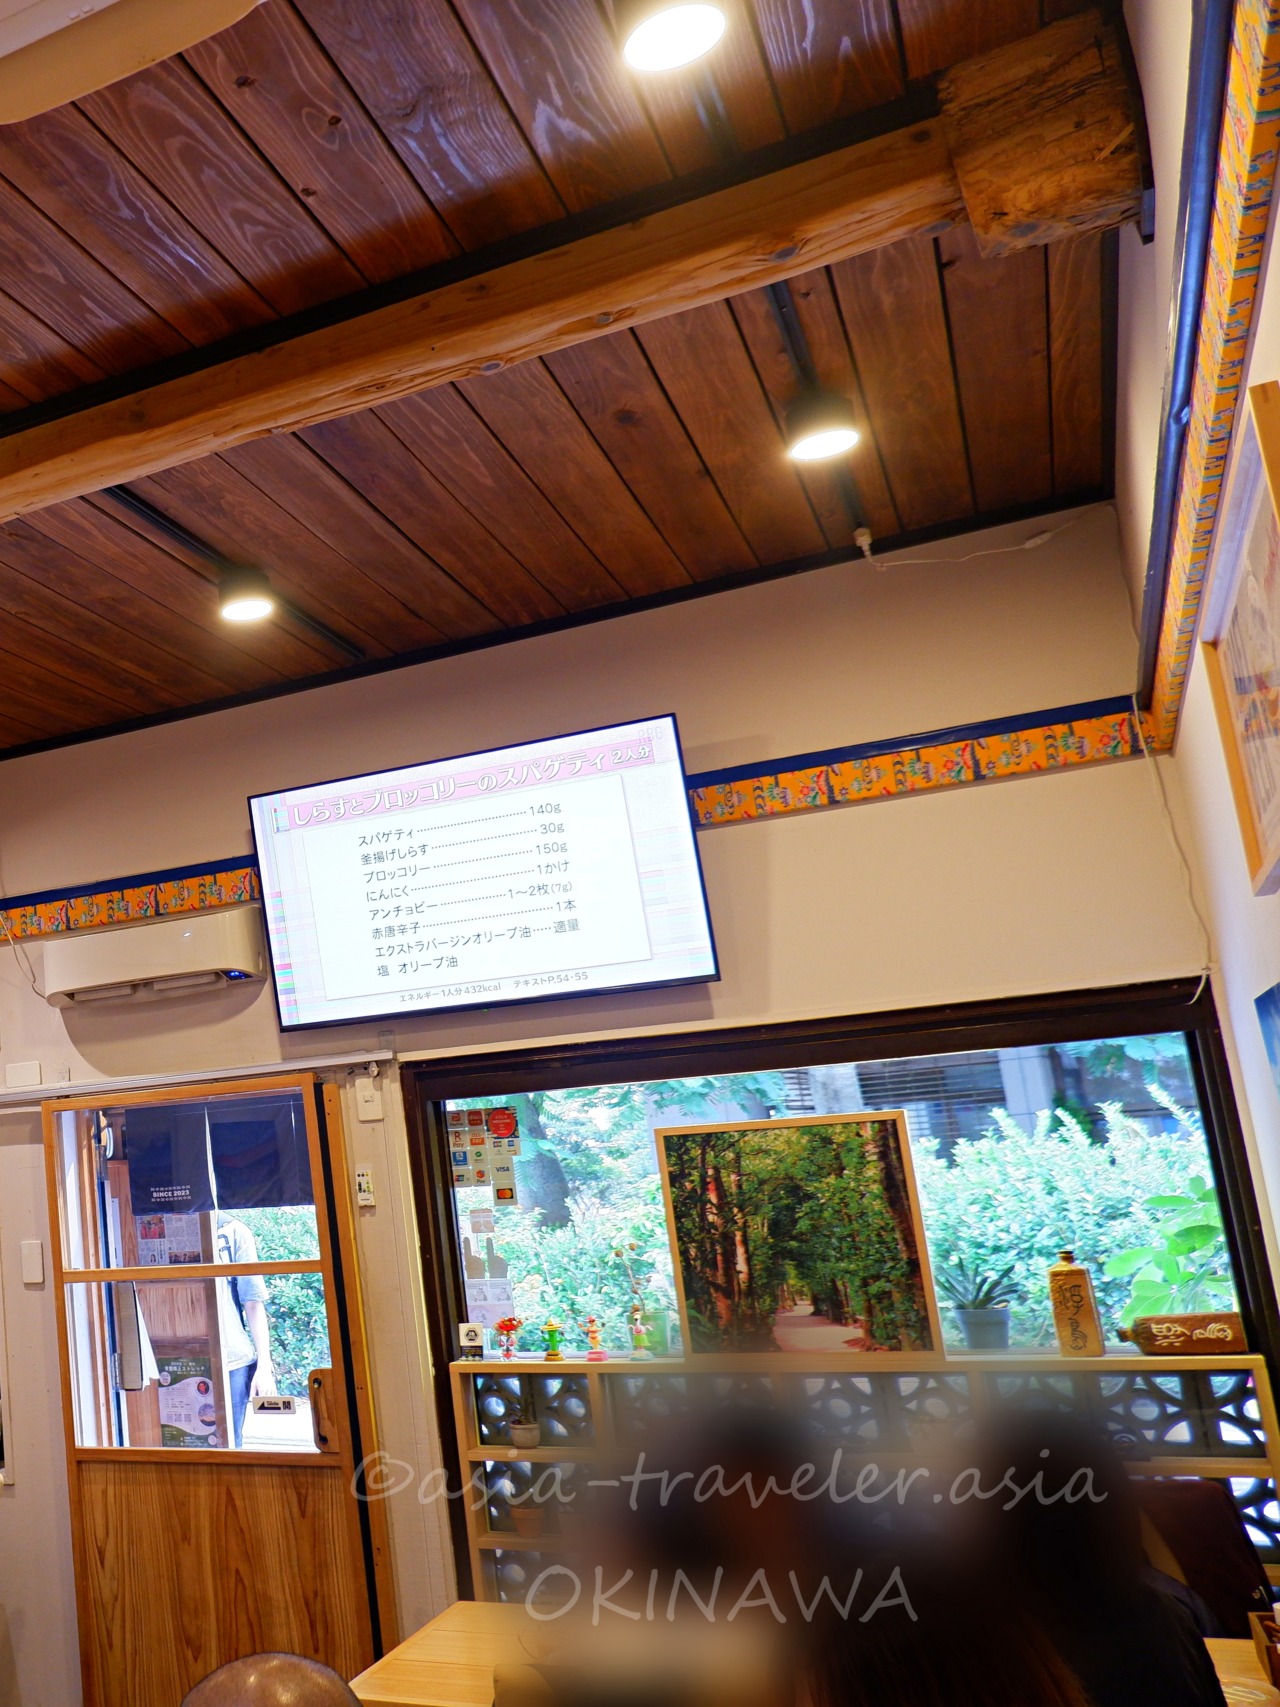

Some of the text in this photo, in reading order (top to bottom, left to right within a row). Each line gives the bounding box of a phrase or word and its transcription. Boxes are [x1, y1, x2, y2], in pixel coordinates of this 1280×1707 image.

[292, 745, 651, 827] しらすとブロッコリーのスパゲティ 2人分
[357, 802, 562, 847] スパゲティ 140g
[360, 822, 565, 866] 釜揚げしらす 30g
[363, 841, 568, 884] ブロッコリー 150g
[366, 859, 570, 903] にんにく 1かけ
[368, 901, 438, 921] アンチョビー
[371, 898, 577, 940] 赤唐辛子 1本
[553, 918, 581, 934] 適量
[377, 955, 459, 977] 塩 オリーブ油
